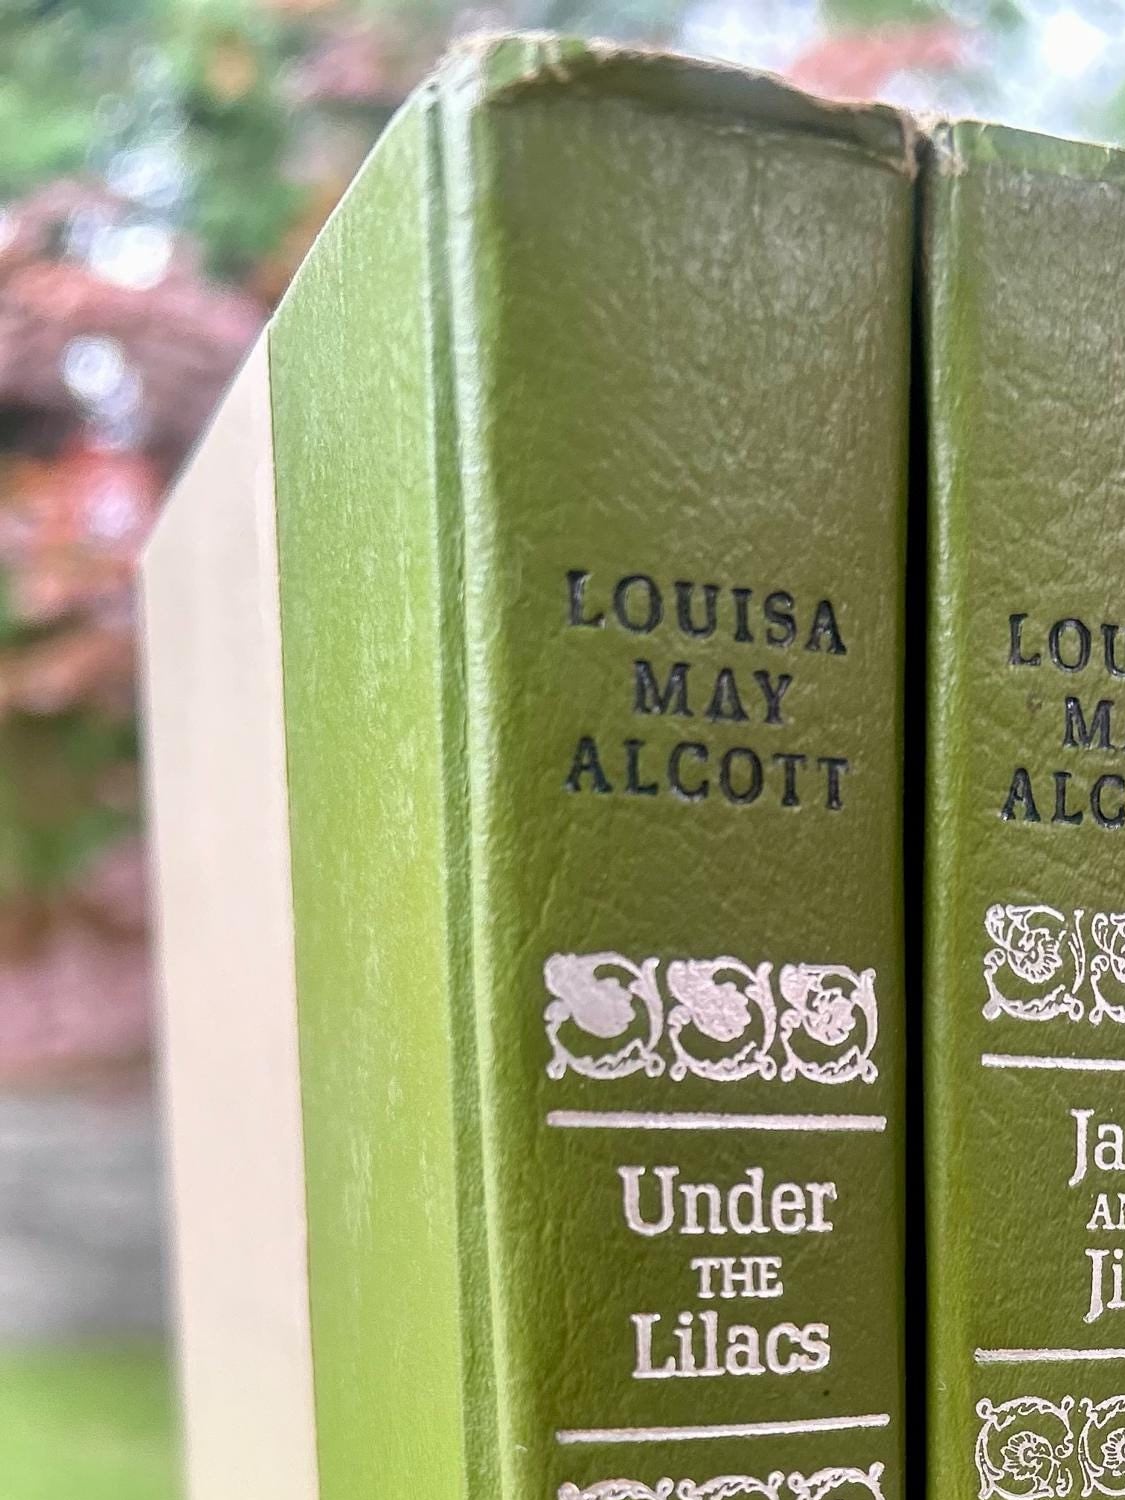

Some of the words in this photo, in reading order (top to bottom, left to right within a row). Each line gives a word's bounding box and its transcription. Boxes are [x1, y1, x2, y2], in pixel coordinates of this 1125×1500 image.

[567, 570, 847, 655] LOUISA
[632, 661, 793, 726] MAY
[564, 735, 850, 812] ALCOTT
[618, 1166, 838, 1237] Under
[692, 1257, 783, 1299] THE
[631, 1313, 831, 1380] Lilacs
